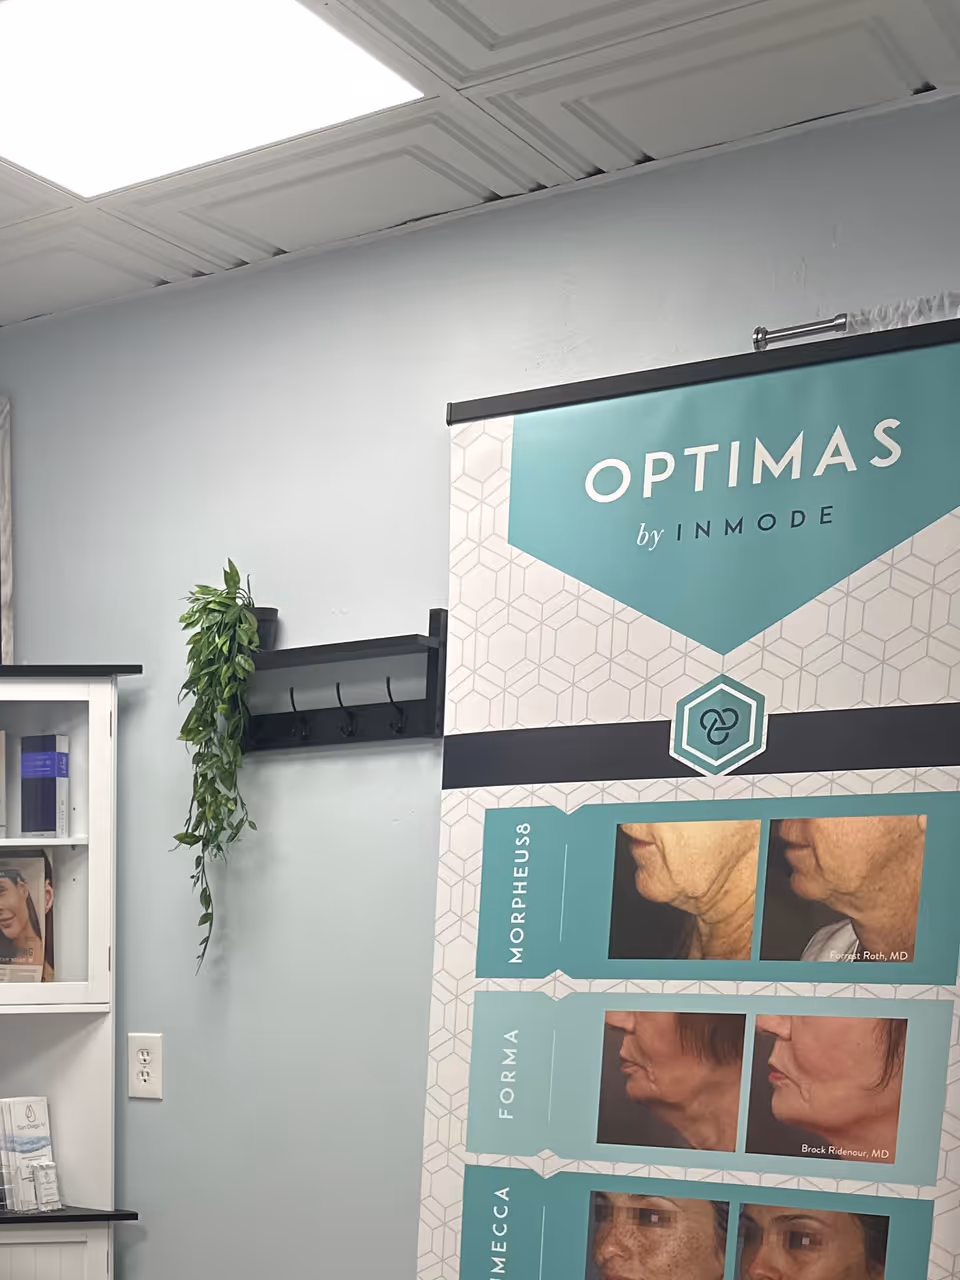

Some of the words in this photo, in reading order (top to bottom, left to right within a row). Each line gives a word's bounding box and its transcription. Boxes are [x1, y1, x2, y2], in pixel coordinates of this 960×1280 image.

[585, 418, 903, 503] OPTIMAS
[636, 523, 664, 551] by
[676, 506, 833, 541] INMODE
[508, 822, 531, 964] MORPHEUS8
[830, 951, 860, 960] Forrest
[863, 951, 887, 961] Roth,
[889, 952, 908, 960] MD
[498, 1029, 520, 1120] FORMA
[801, 1144, 826, 1154] Brock
[828, 1146, 869, 1158] Ridenour,
[871, 1149, 889, 1158] MD
